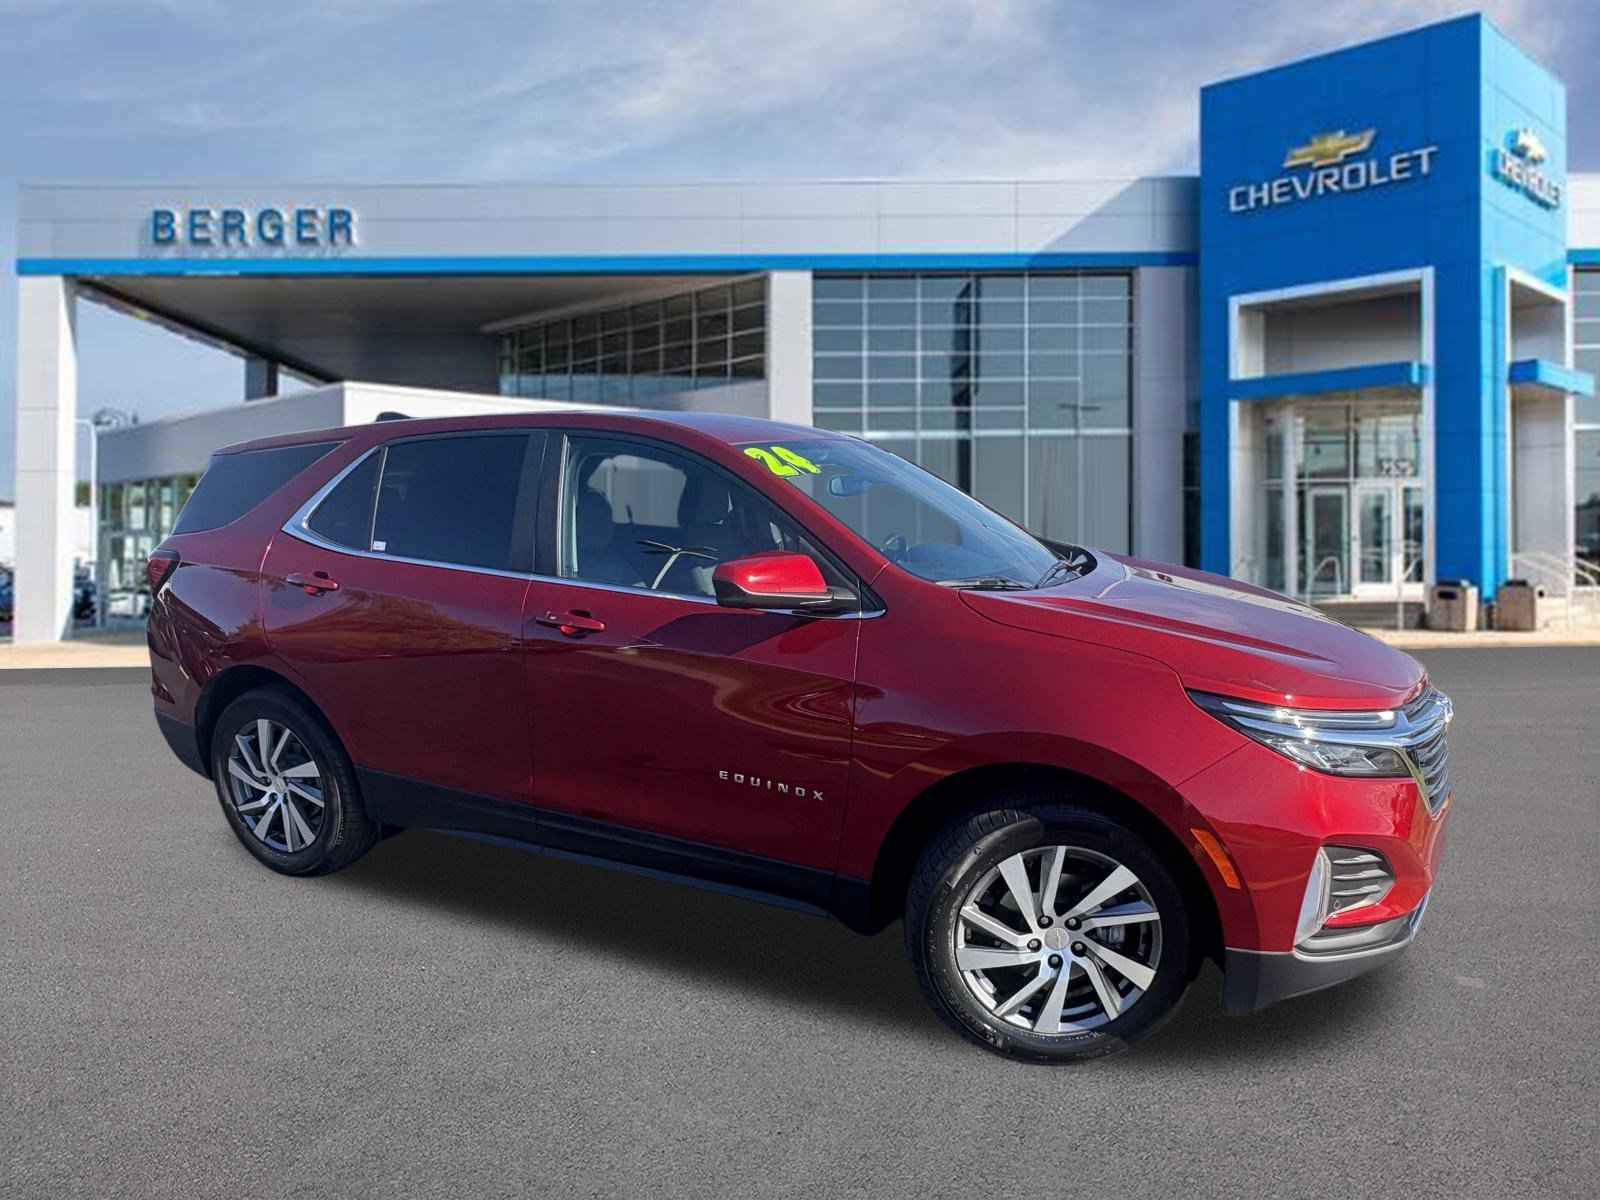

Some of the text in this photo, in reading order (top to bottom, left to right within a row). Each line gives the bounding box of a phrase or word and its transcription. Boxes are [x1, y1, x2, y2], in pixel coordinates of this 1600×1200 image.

[1229, 146, 1438, 213] CHEVROLET
[152, 208, 357, 246] BERGER
[743, 446, 823, 477] 24
[719, 770, 824, 801] EQUINOX
